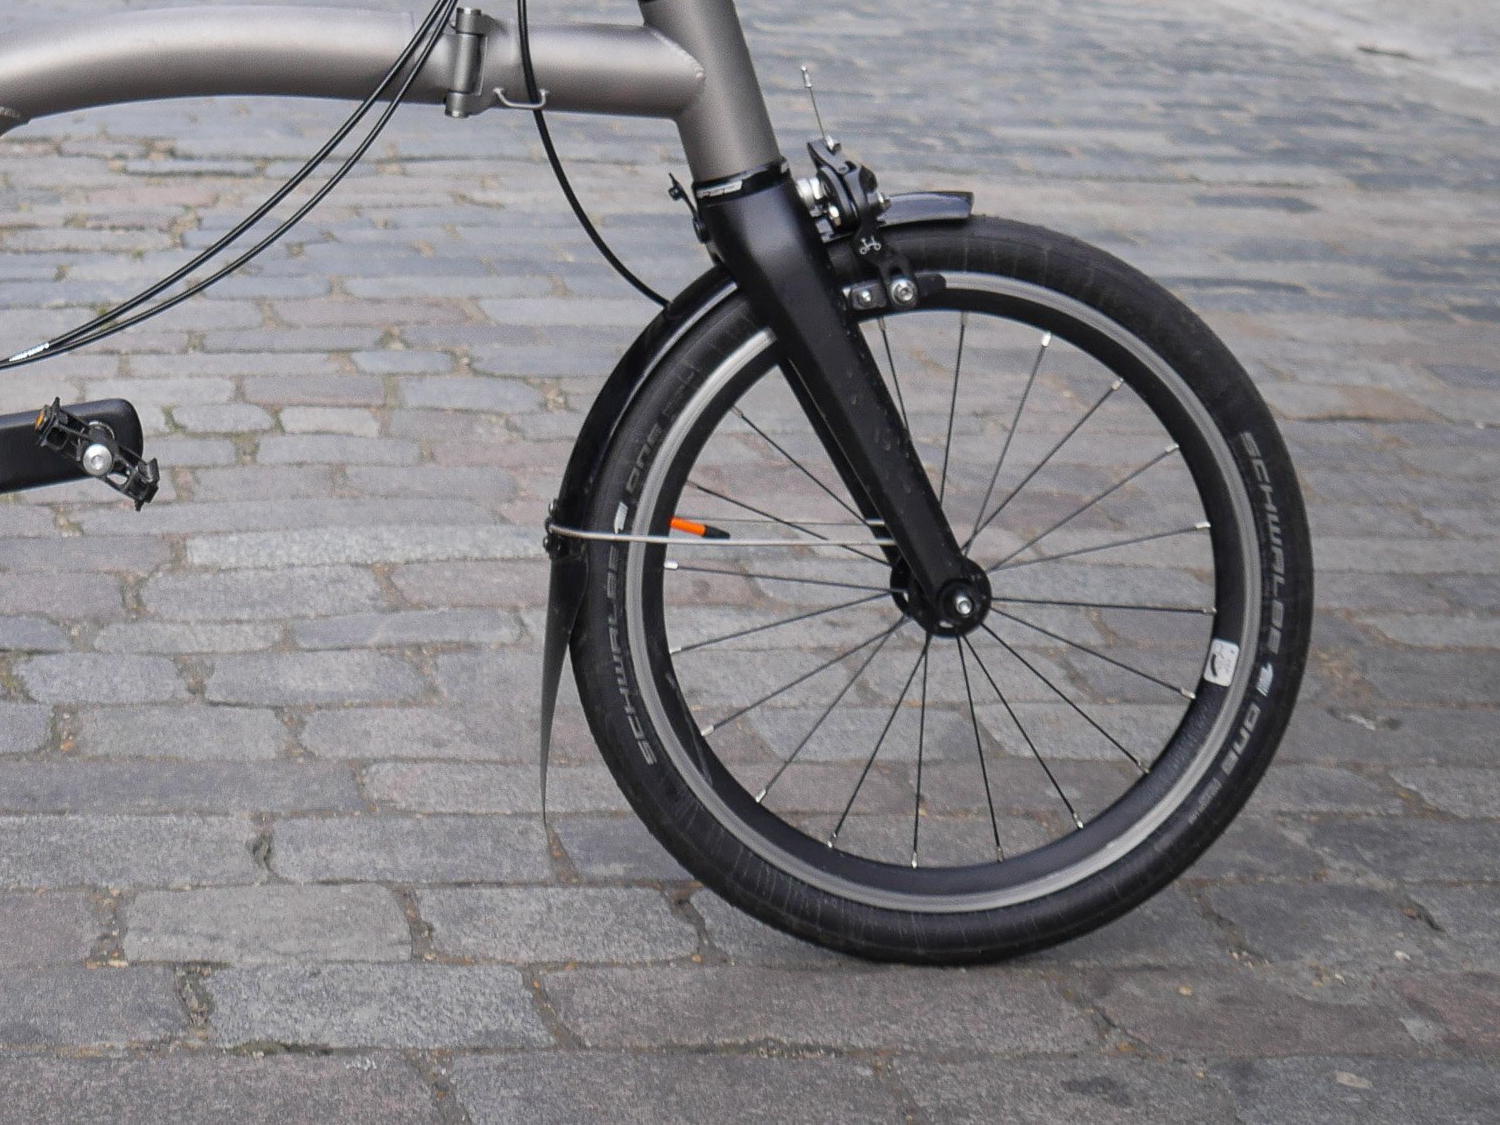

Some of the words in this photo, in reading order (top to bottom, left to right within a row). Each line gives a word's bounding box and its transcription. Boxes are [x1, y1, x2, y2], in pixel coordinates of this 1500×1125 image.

[1238, 431, 1287, 655] SCHWALBE
[607, 544, 658, 766] SCHWALBE
[1220, 702, 1262, 776] ONE
